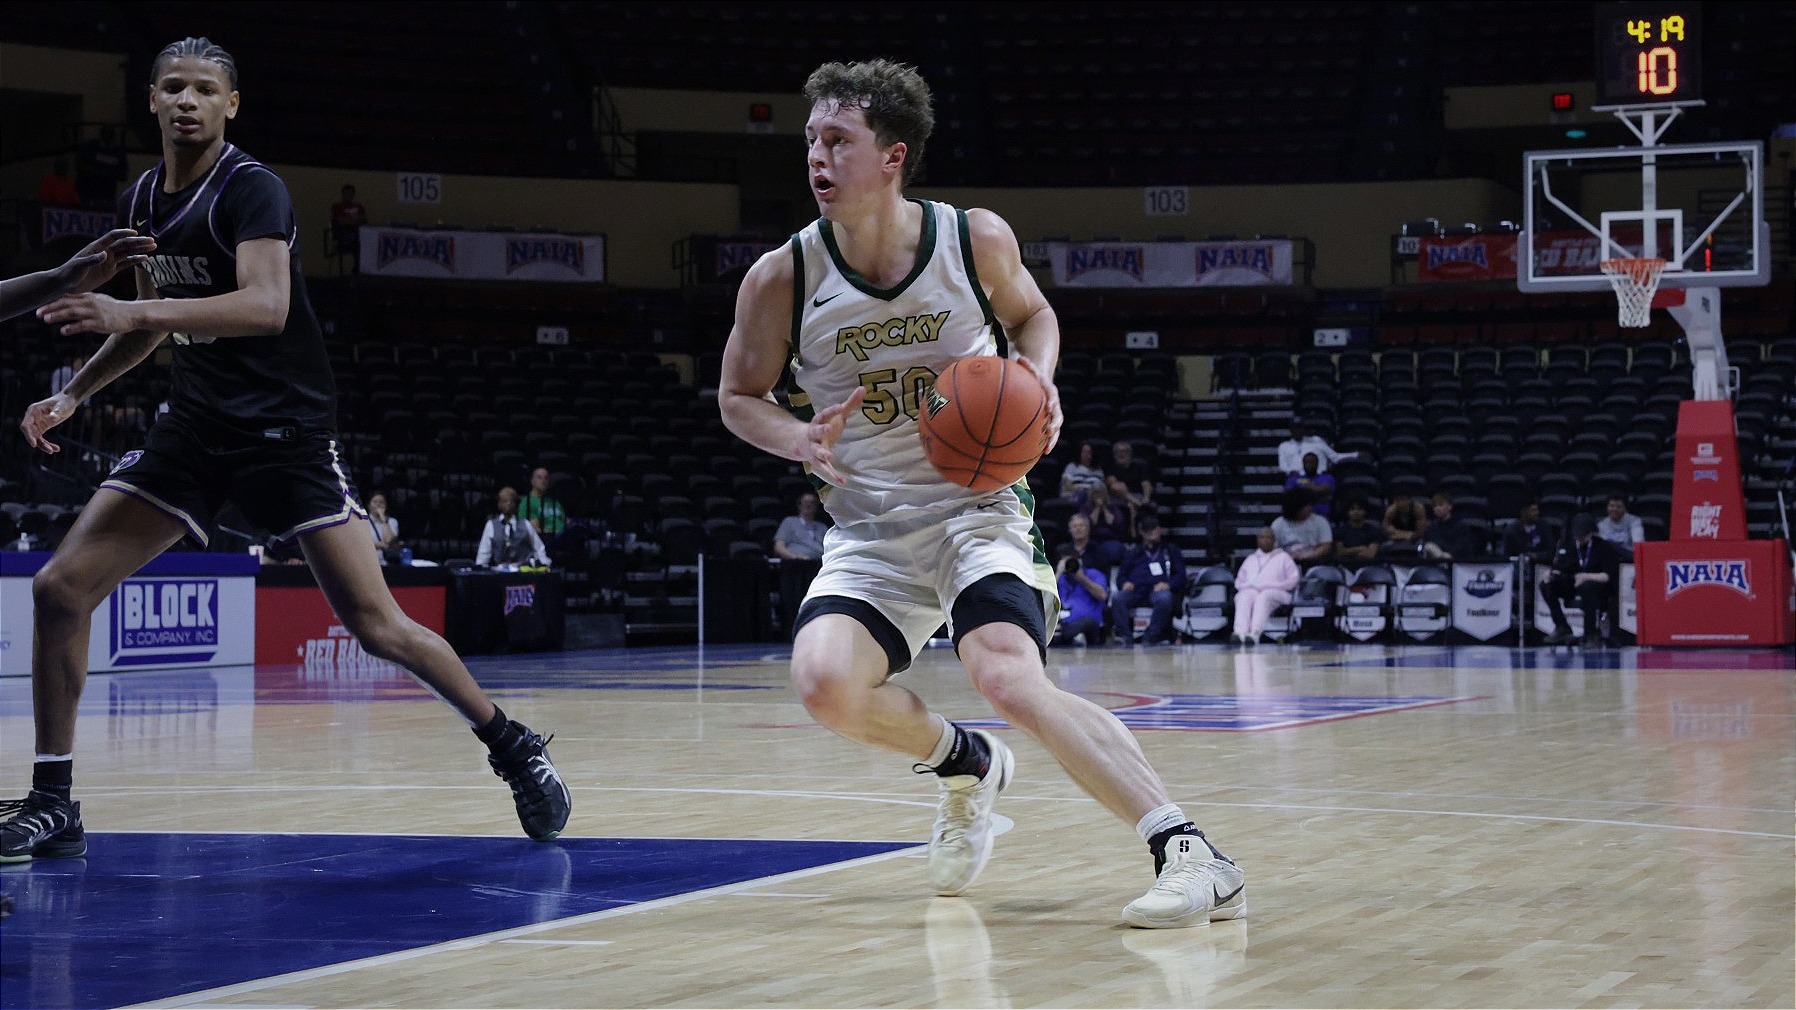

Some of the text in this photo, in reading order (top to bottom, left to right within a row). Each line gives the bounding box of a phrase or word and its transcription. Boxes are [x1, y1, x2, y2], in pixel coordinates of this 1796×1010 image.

[1638, 46, 1677, 95] 10
[400, 176, 439, 201] 105
[1149, 191, 1187, 213] 103
[382, 234, 453, 267] NAIA
[508, 238, 583, 269] NAIA
[1069, 248, 1142, 276] NAIA
[1198, 247, 1271, 275] NAIA
[1429, 245, 1487, 269] NAIA
[836, 310, 951, 361] ROCKY
[858, 366, 939, 425] 50
[1668, 562, 1748, 592] NAIA
[124, 583, 215, 630] BLOCK
[125, 632, 134, 646] &
